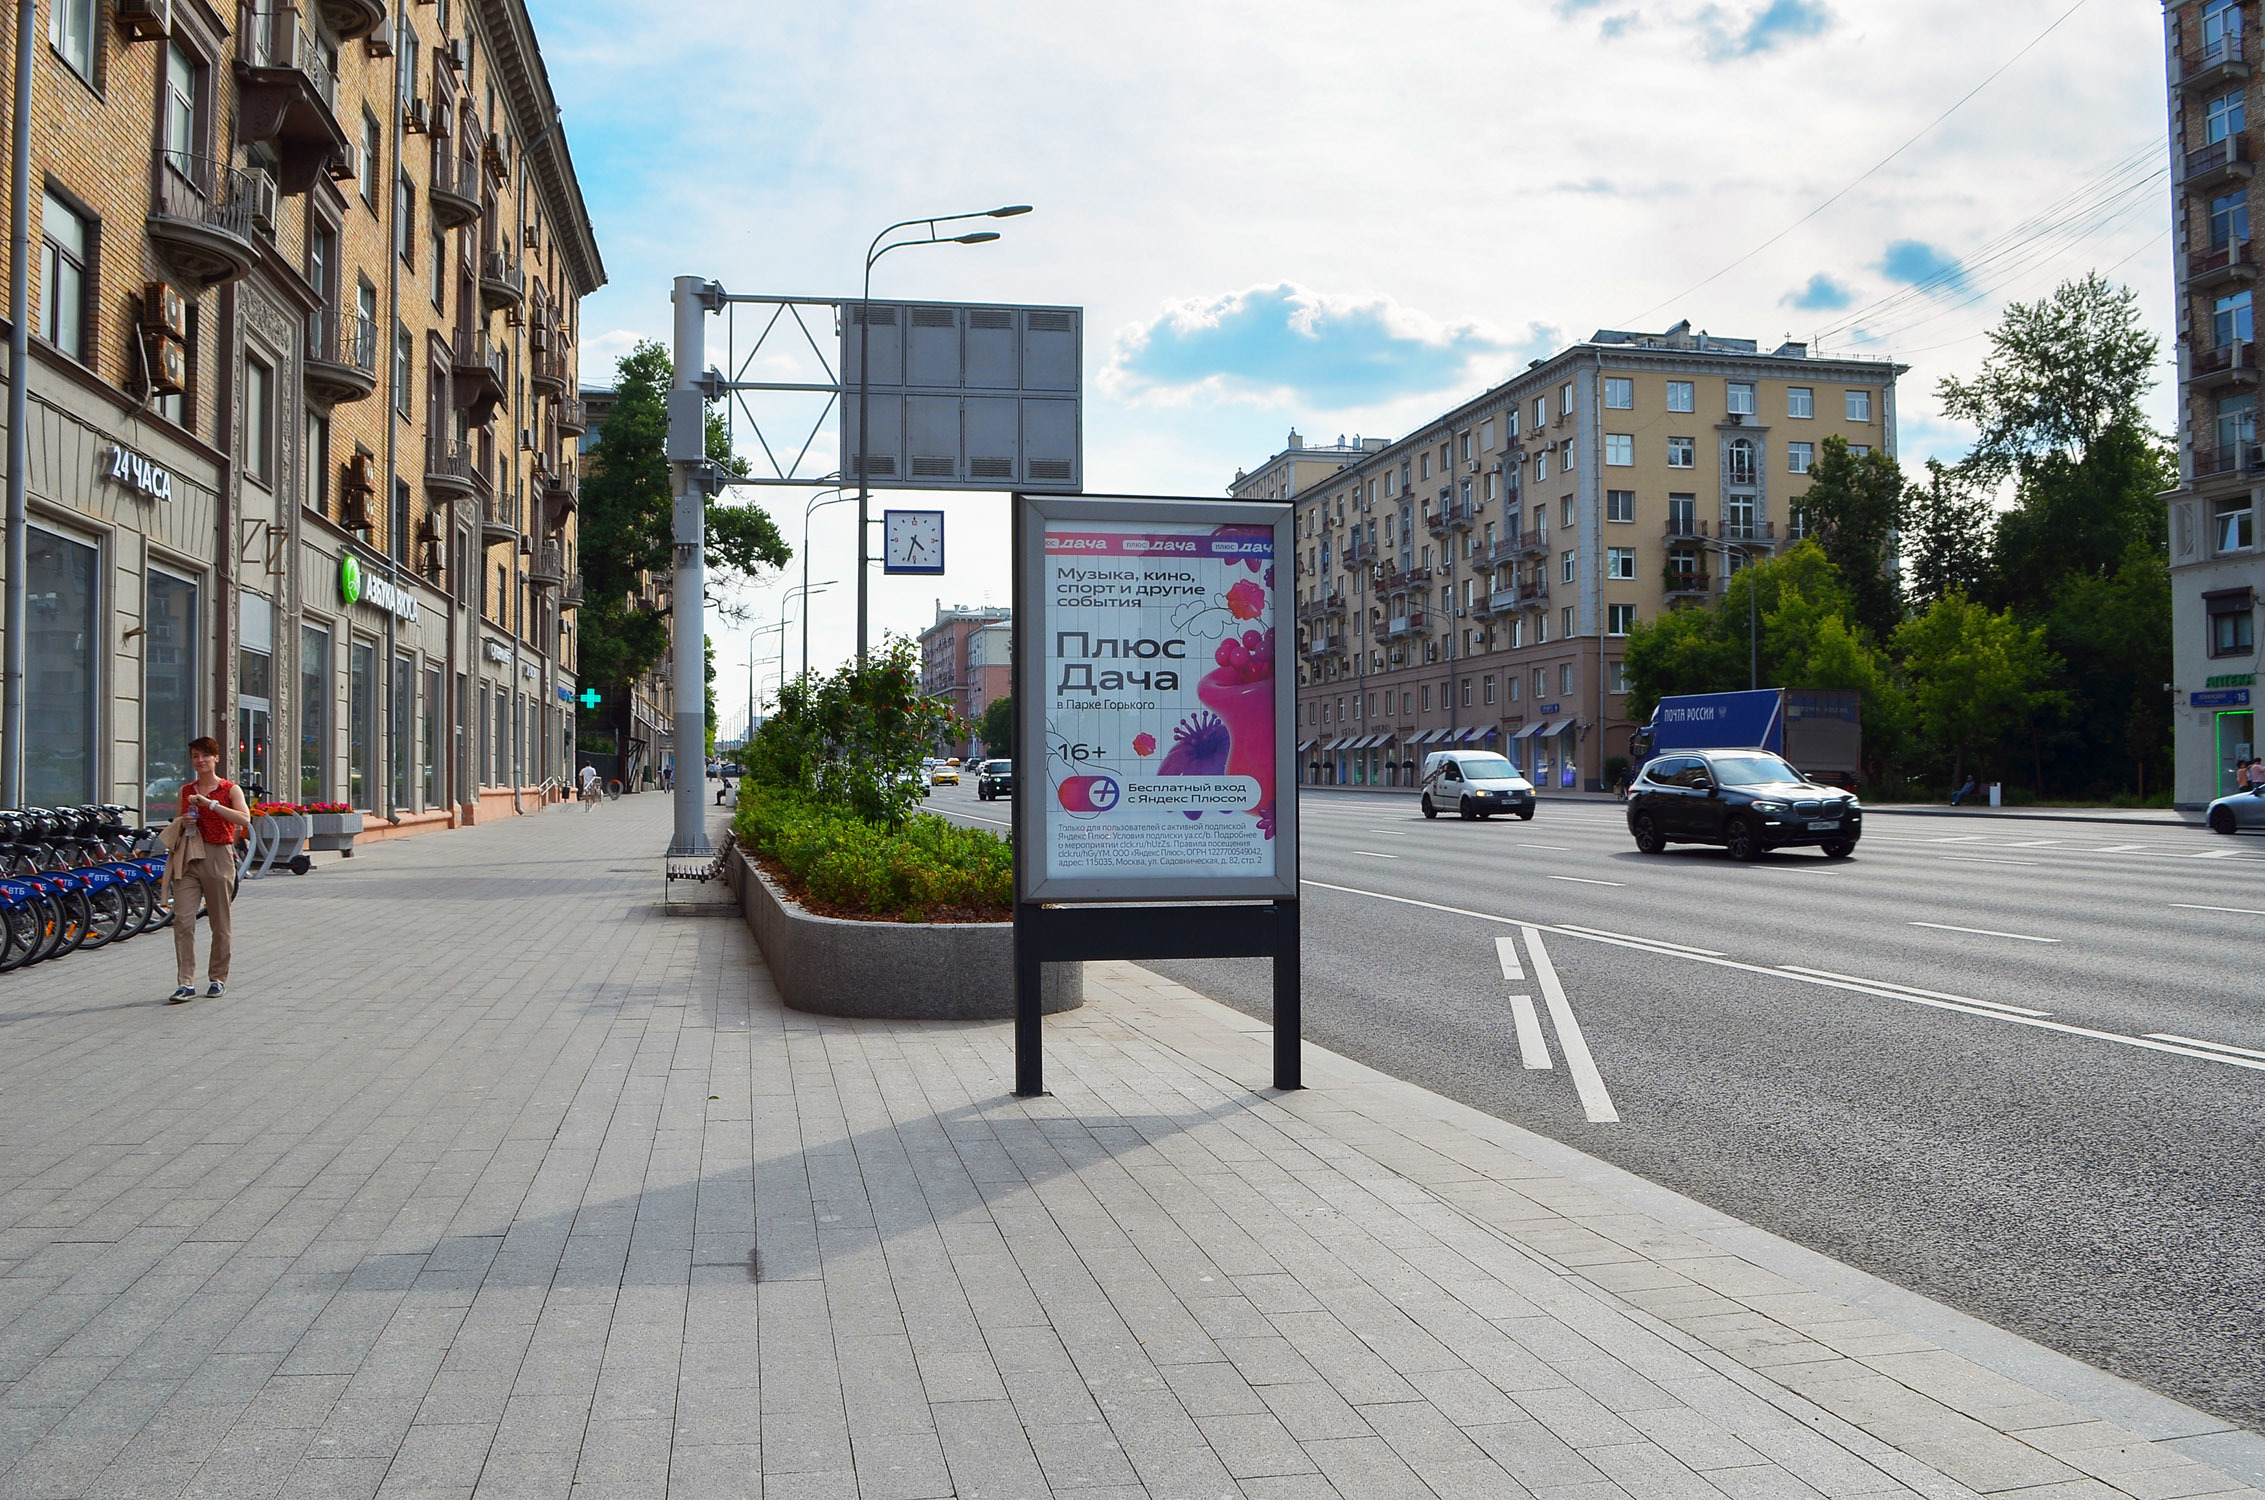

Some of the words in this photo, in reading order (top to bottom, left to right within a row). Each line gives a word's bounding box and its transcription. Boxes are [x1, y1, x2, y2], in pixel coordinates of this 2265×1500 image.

[113, 445, 129, 481] 24
[132, 455, 172, 503] ЧАСА
[1060, 539, 1107, 549] дача
[1150, 541, 1197, 552] дача
[1238, 543, 1274, 553] дач
[1057, 567, 1139, 582] Музыка,
[1144, 571, 1195, 583] кино,
[365, 573, 396, 612] АЗБУКА
[1057, 584, 1116, 596] спорт
[1120, 585, 1132, 594] и
[1135, 585, 1206, 597] другие
[1057, 596, 1141, 608] события
[1057, 631, 1186, 659] Плюс
[1057, 664, 1179, 696] Дача
[2206, 673, 2254, 688] АПТЕКА
[2237, 692, 2246, 701] 16
[1057, 701, 1063, 709] в
[1066, 699, 1102, 711] Парке
[1104, 699, 1155, 711] Горького
[1664, 707, 1686, 722] ПОЧТА
[1686, 706, 1714, 721] РОССИИ
[1058, 743, 1107, 761] 16+
[1128, 783, 1211, 792] Бесплатный
[1214, 784, 1247, 792] вход
[1138, 795, 1189, 804] Яндекс
[1191, 795, 1247, 803] Плюсом
[1058, 823, 1085, 832] Только
[1102, 823, 1160, 832] пользователей
[1167, 823, 1204, 831] активной
[1204, 823, 1247, 832] подпиской
[1058, 832, 1086, 841] Яндекс
[1112, 832, 1145, 840] Условия
[1145, 833, 1183, 841] подписки
[1213, 831, 1258, 840] Подробнее
[1065, 842, 1119, 850] мероприятии
[1173, 840, 1207, 849] Правила
[1208, 840, 1251, 849] посещения
[1112, 849, 1130, 857] ООО
[1186, 848, 1207, 856] ОГРН
[1058, 859, 1084, 867] адрес:
[1085, 858, 1115, 866] 115035,
[1116, 858, 1147, 866] Москва,
[1147, 859, 1158, 867] ул.
[1159, 857, 1220, 866] Садовническая,
[1229, 857, 1240, 865] 82,
[1241, 857, 1256, 866] стр.
[1257, 856, 1262, 864] 2
[151, 864, 166, 872] ВТБ
[94, 874, 110, 882] ВТБ
[8, 887, 25, 896] ВТБ
